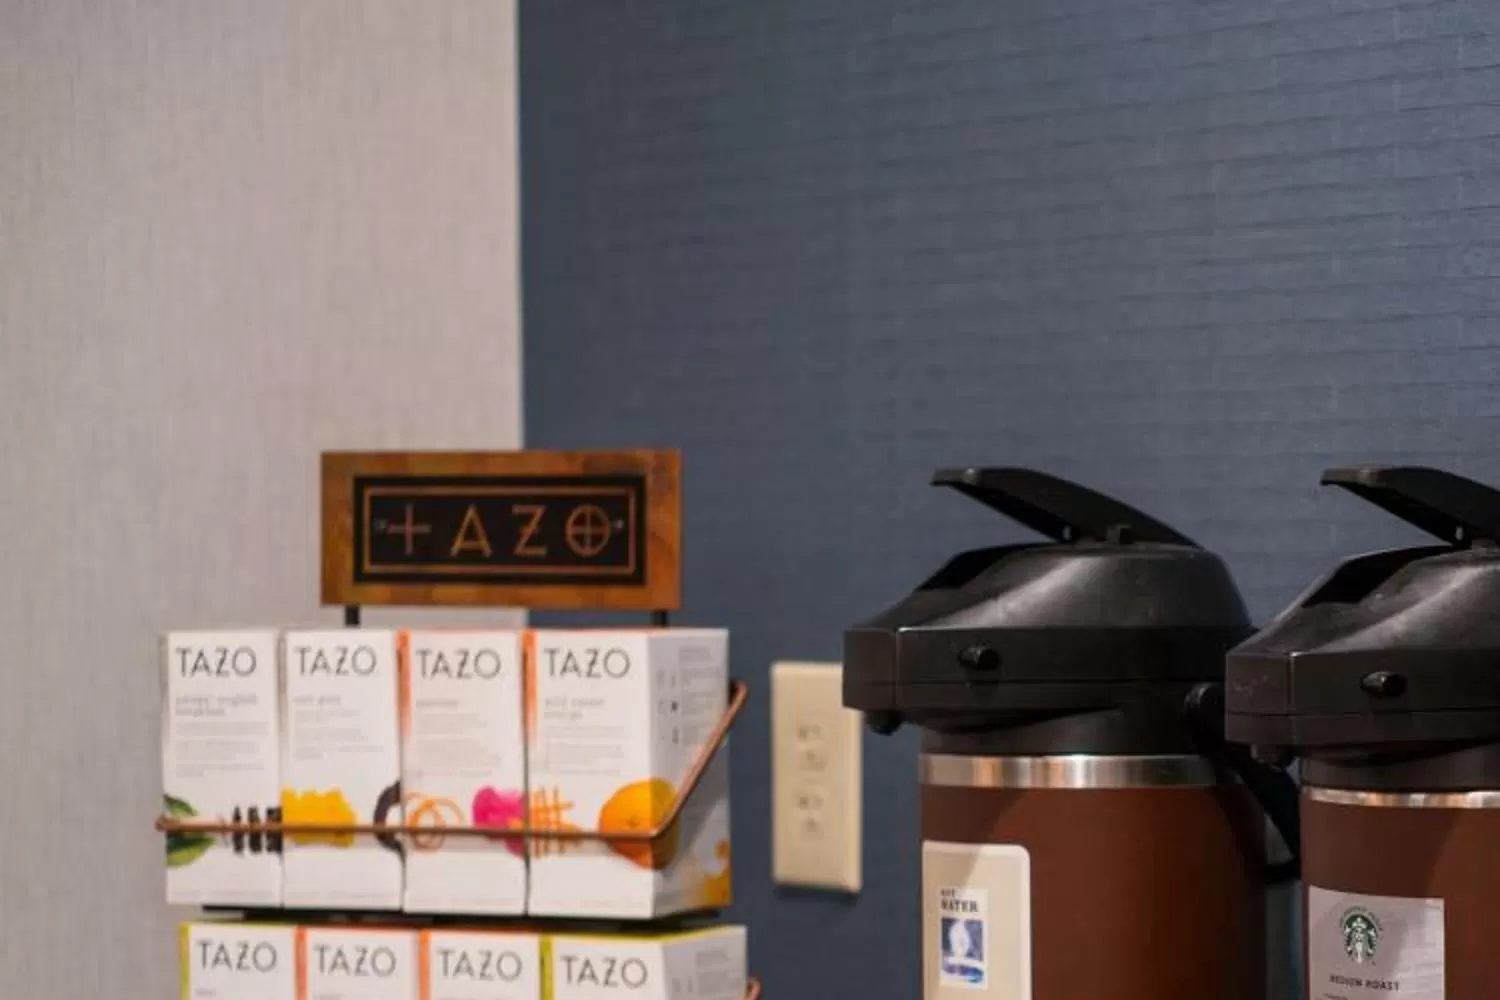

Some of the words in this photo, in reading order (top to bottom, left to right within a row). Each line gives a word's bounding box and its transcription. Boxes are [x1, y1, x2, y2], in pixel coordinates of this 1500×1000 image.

[175, 647, 257, 677] TAZO
[293, 645, 377, 676] TAZO
[416, 648, 501, 679] TAZO
[543, 648, 631, 680] TAZO
[196, 938, 278, 973] TAZO
[313, 943, 397, 978] TAZO
[437, 949, 522, 982] TAZO
[561, 955, 648, 988] TAZO
[1365, 979, 1400, 991] ROAST
